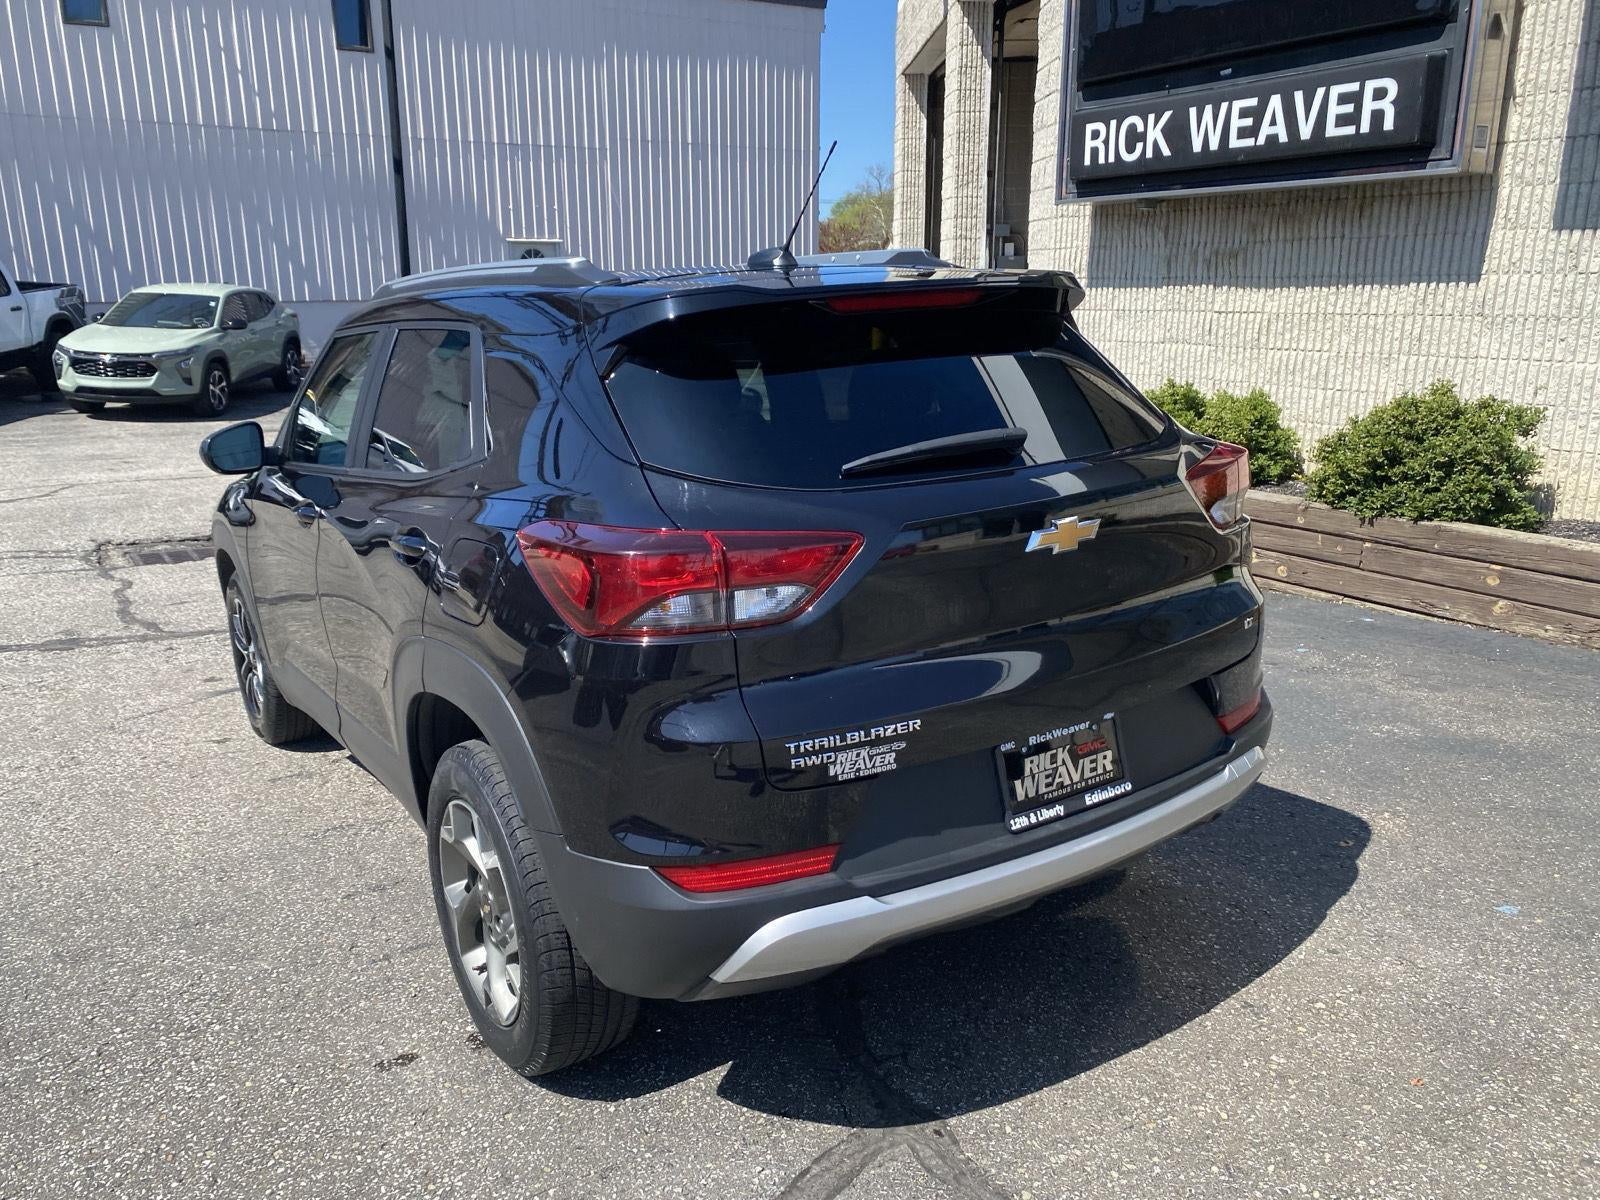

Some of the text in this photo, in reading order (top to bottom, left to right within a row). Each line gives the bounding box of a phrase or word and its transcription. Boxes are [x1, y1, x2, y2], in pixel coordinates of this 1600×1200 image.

[1083, 77, 1400, 166] RICK WEAVER
[785, 719, 922, 755] TRAILBLAZER
[1028, 721, 1091, 746] RickWeaver
[1077, 736, 1107, 755] GMC
[836, 747, 870, 764] RICK
[1000, 741, 1016, 752] GMC
[791, 752, 836, 769] AWD
[829, 752, 896, 777] WEAVER
[838, 763, 897, 781] ERIE EDINBORO
[1024, 744, 1071, 777] RICK
[1014, 749, 1114, 802] WEAVER
[1044, 771, 1114, 800] FAMOUS FOR SERVICE
[1084, 781, 1133, 805] Edinboro
[1009, 804, 1065, 831] 12th & Liberty
